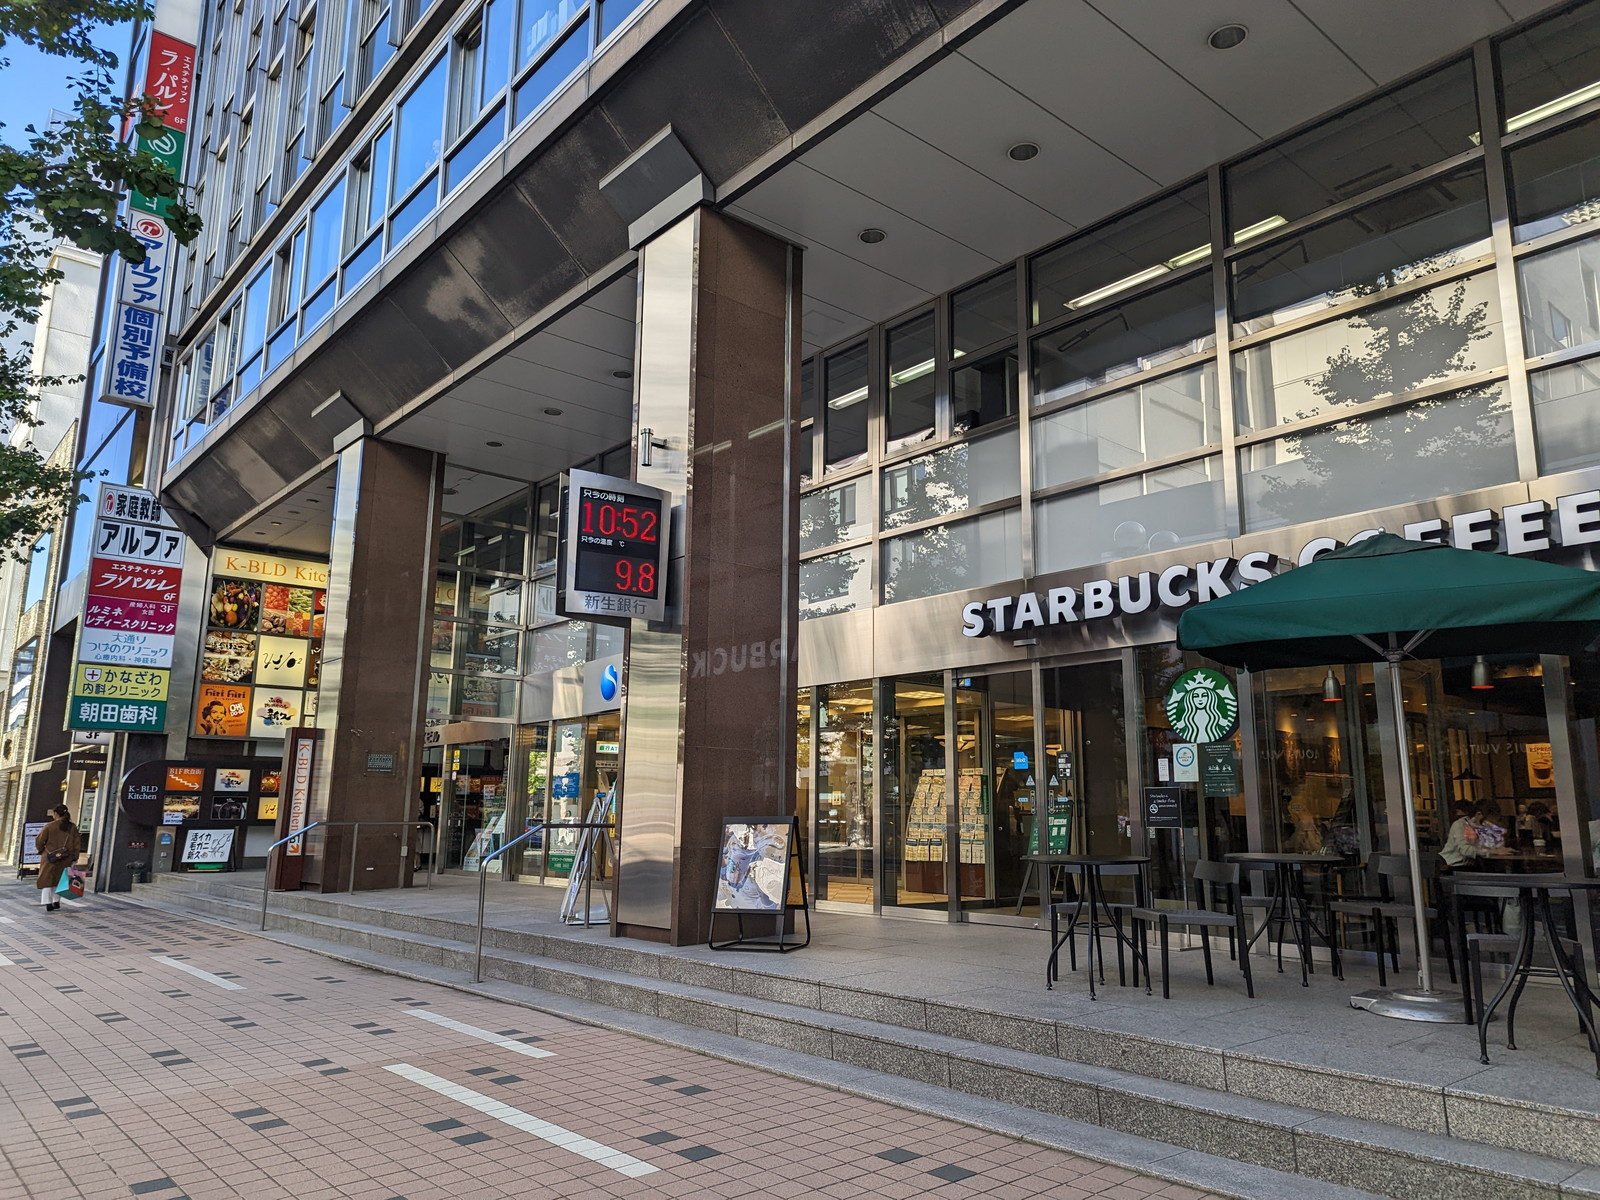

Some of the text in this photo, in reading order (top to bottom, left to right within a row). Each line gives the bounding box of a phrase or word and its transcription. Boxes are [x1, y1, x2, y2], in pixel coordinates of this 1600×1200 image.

[174, 116, 186, 125] 6F
[114, 306, 155, 400] 個別予備校
[583, 490, 625, 503] 只今の時刻
[116, 493, 161, 522] 家庭教師
[582, 501, 657, 541] 10:52
[101, 523, 180, 559] アルファ
[581, 536, 613, 546] 只今の温度
[111, 563, 164, 575] エステティック
[225, 556, 287, 577] K-BLD
[615, 559, 655, 593] 9.8
[163, 593, 176, 601] 6F
[962, 551, 1274, 638] STARBUCKS
[88, 605, 123, 617] ルミネ
[160, 605, 174, 613] 3F
[584, 594, 647, 615] 新生銀行
[86, 615, 175, 632] レディースクリニック
[112, 633, 147, 645] 大通り
[105, 669, 162, 686] かなざわ
[82, 683, 161, 698] 内科クリニック
[79, 702, 158, 725] 朝田歯科
[127, 792, 157, 800] Kitchen
